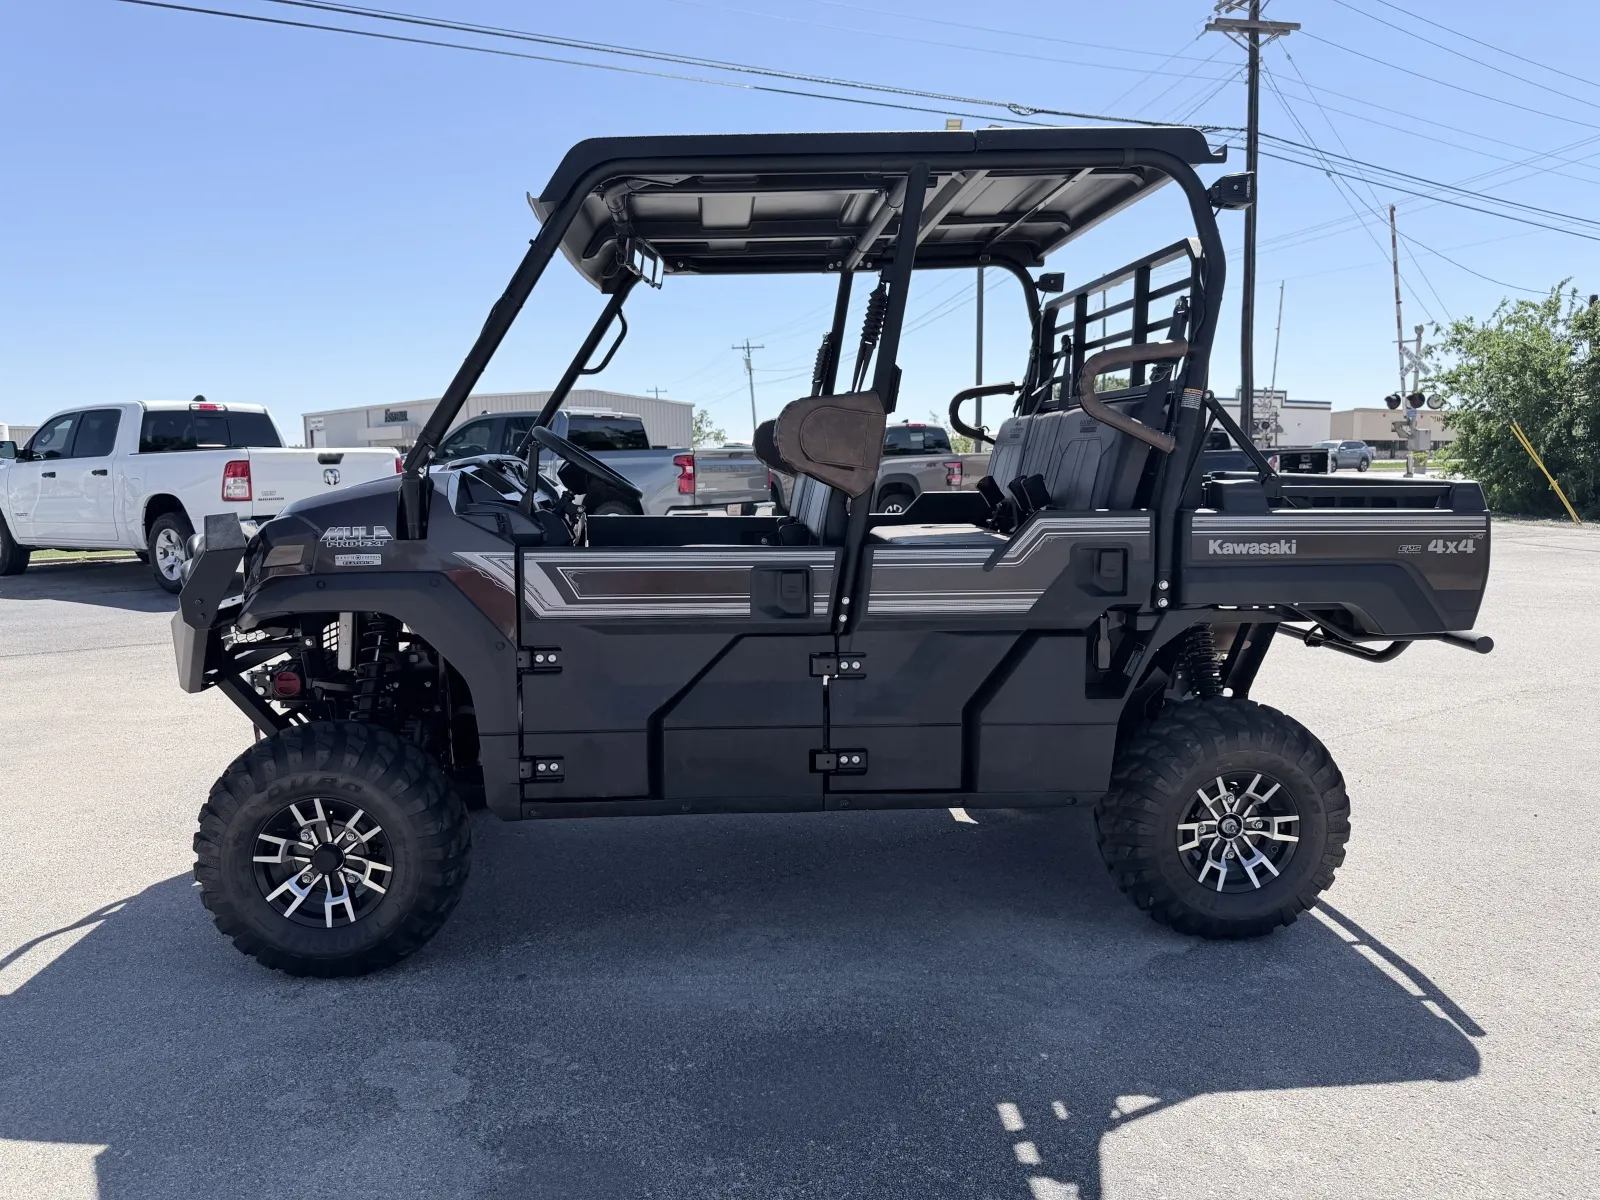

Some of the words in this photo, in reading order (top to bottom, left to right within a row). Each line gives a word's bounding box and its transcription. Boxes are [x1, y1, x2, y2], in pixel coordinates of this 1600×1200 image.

[320, 526, 394, 541] MULE
[1208, 539, 1297, 555] Kawasaki
[1427, 539, 1476, 554] 4x4
